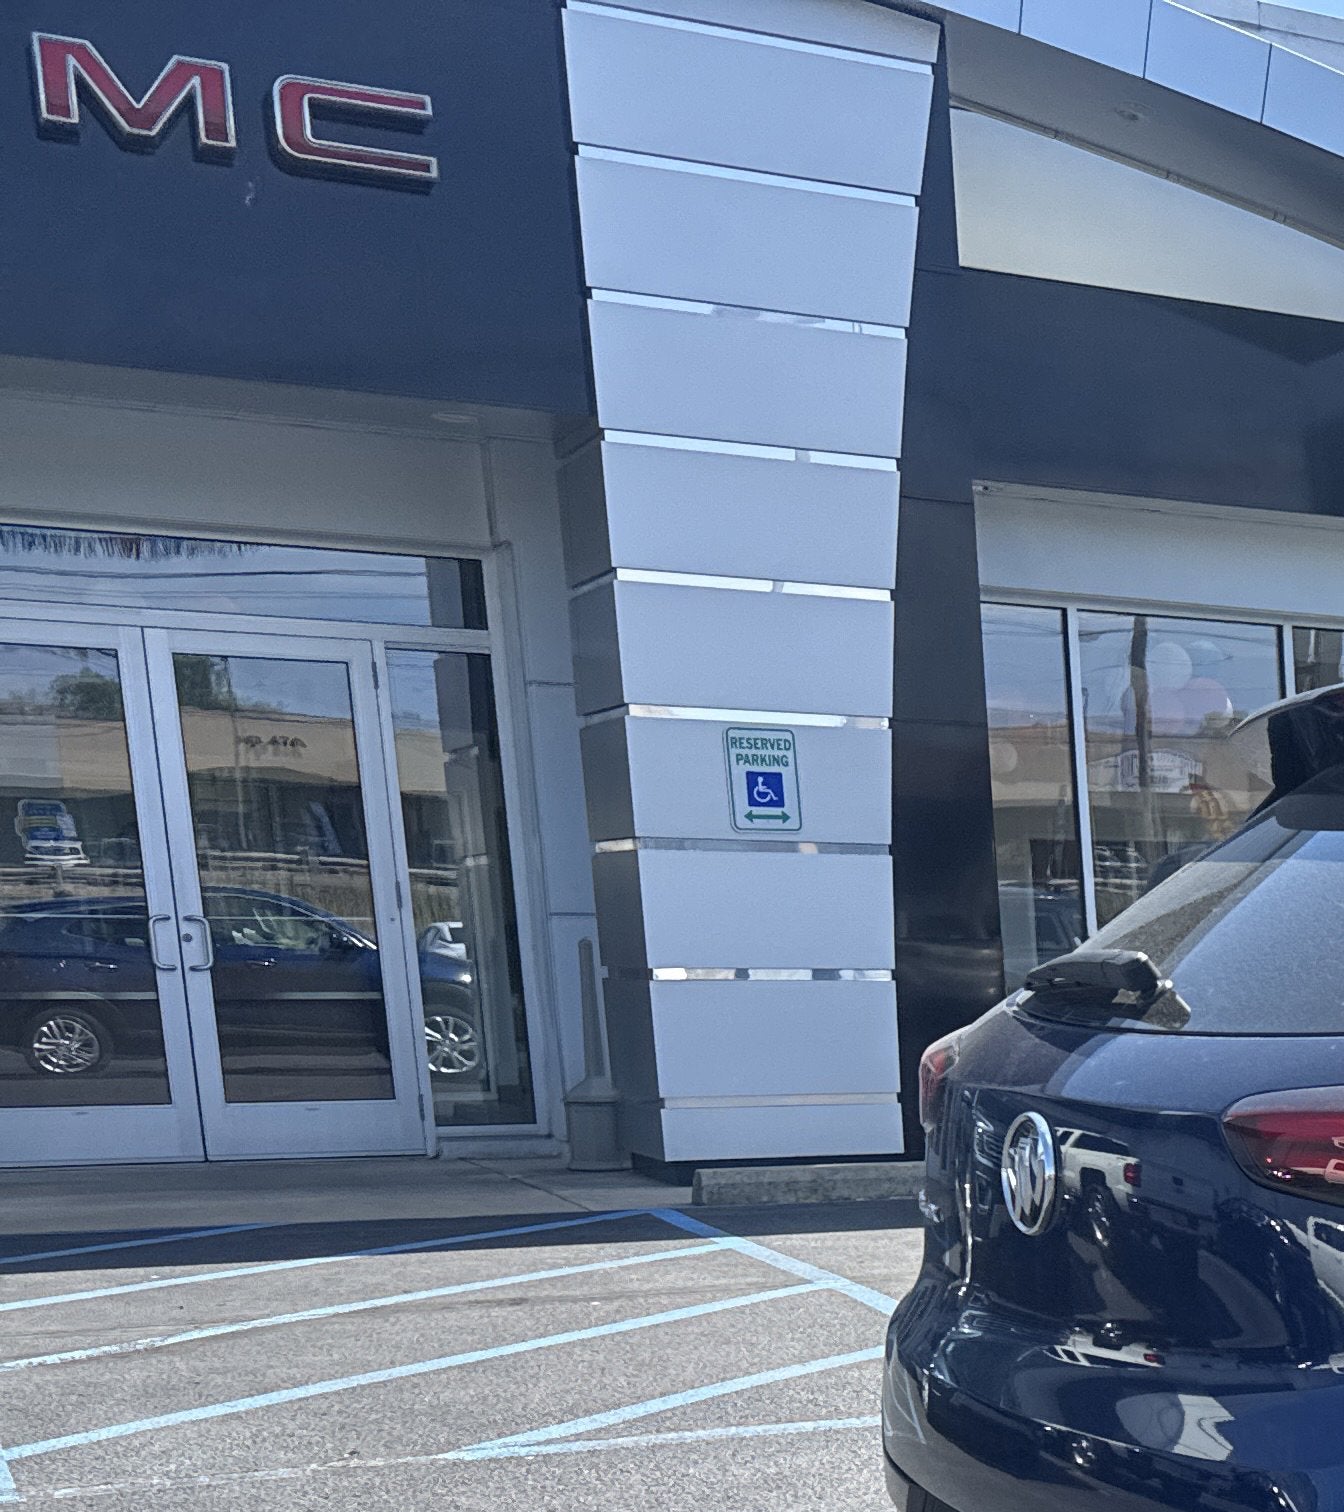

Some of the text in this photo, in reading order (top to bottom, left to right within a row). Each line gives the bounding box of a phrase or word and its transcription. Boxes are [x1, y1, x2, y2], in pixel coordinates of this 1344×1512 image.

[31, 31, 439, 181] MC
[730, 737, 791, 751] RESERVED
[735, 753, 789, 767] PARKING
